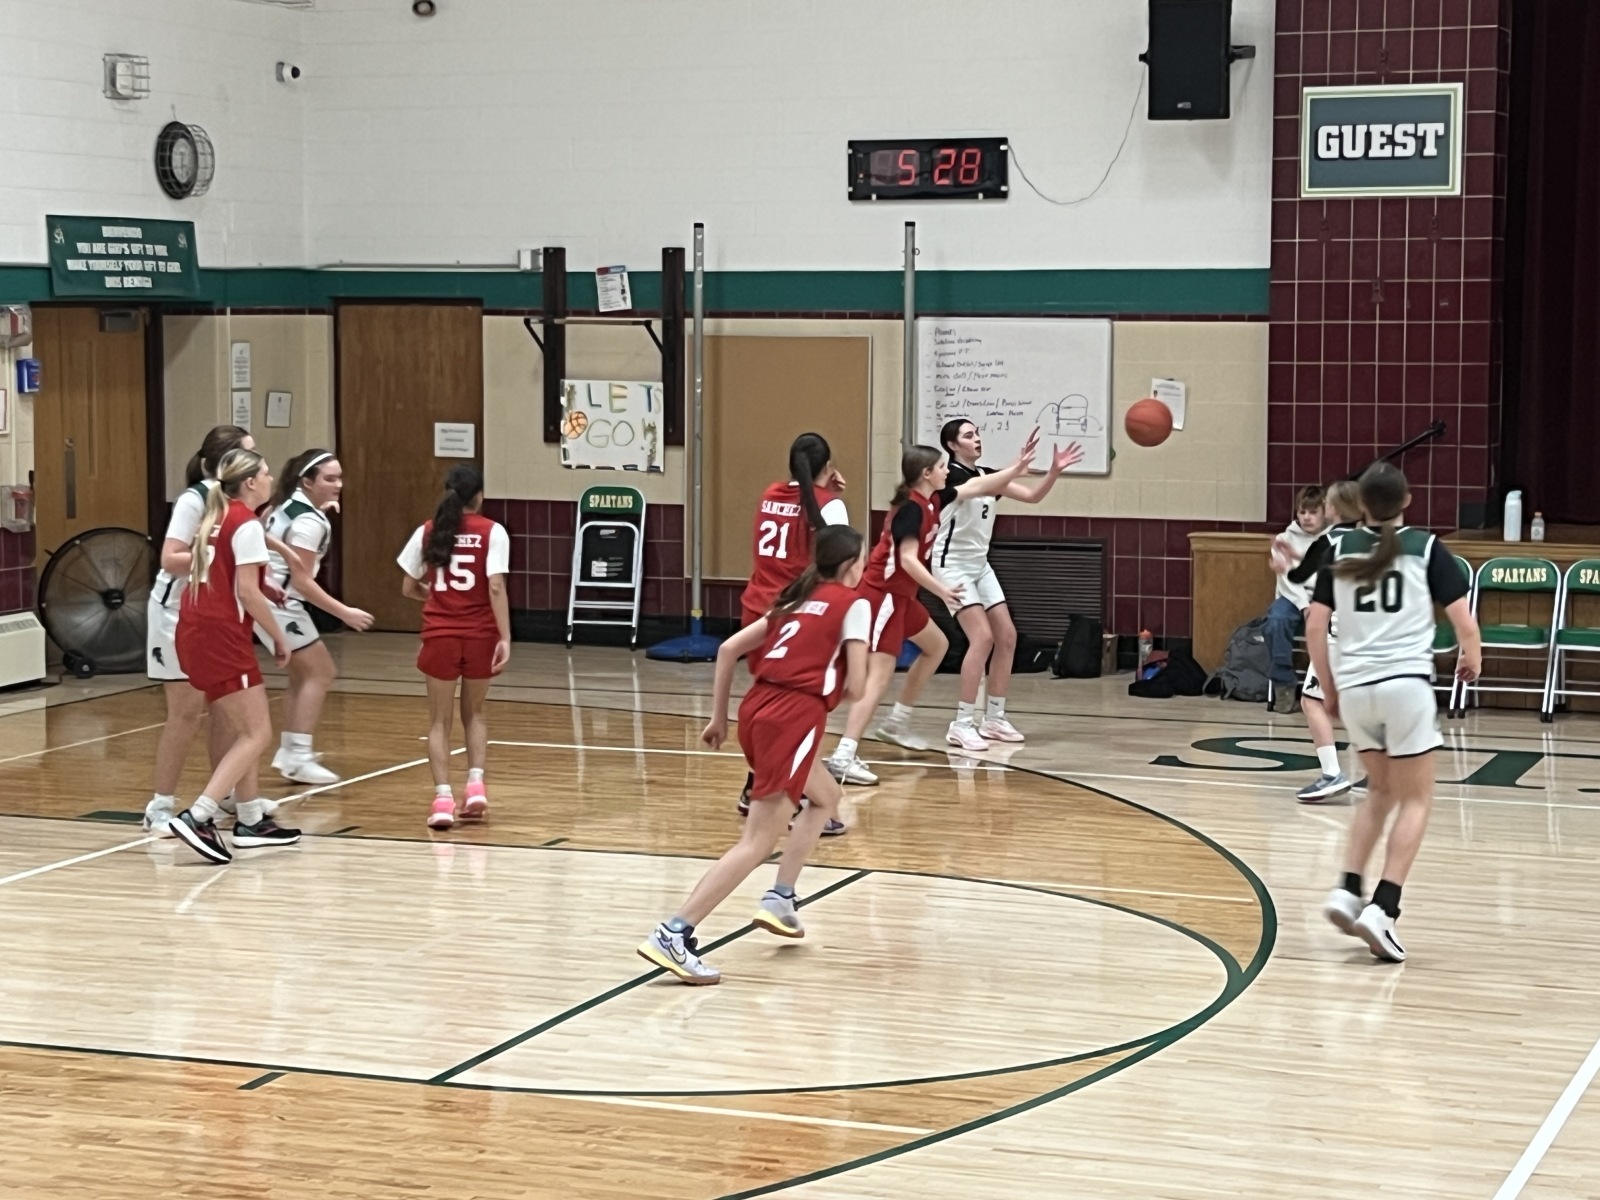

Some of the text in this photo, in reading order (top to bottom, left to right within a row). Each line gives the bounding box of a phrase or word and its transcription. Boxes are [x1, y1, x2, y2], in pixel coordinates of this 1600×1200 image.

[1317, 122, 1445, 159] GUEST
[933, 148, 981, 186] 28
[589, 494, 633, 509] SPARTANS
[981, 504, 990, 520] 2
[758, 520, 790, 559] 21
[434, 554, 475, 592] 15
[1354, 570, 1403, 613] 20
[1491, 567, 1548, 583] SPARTANS
[764, 620, 801, 659] 2
